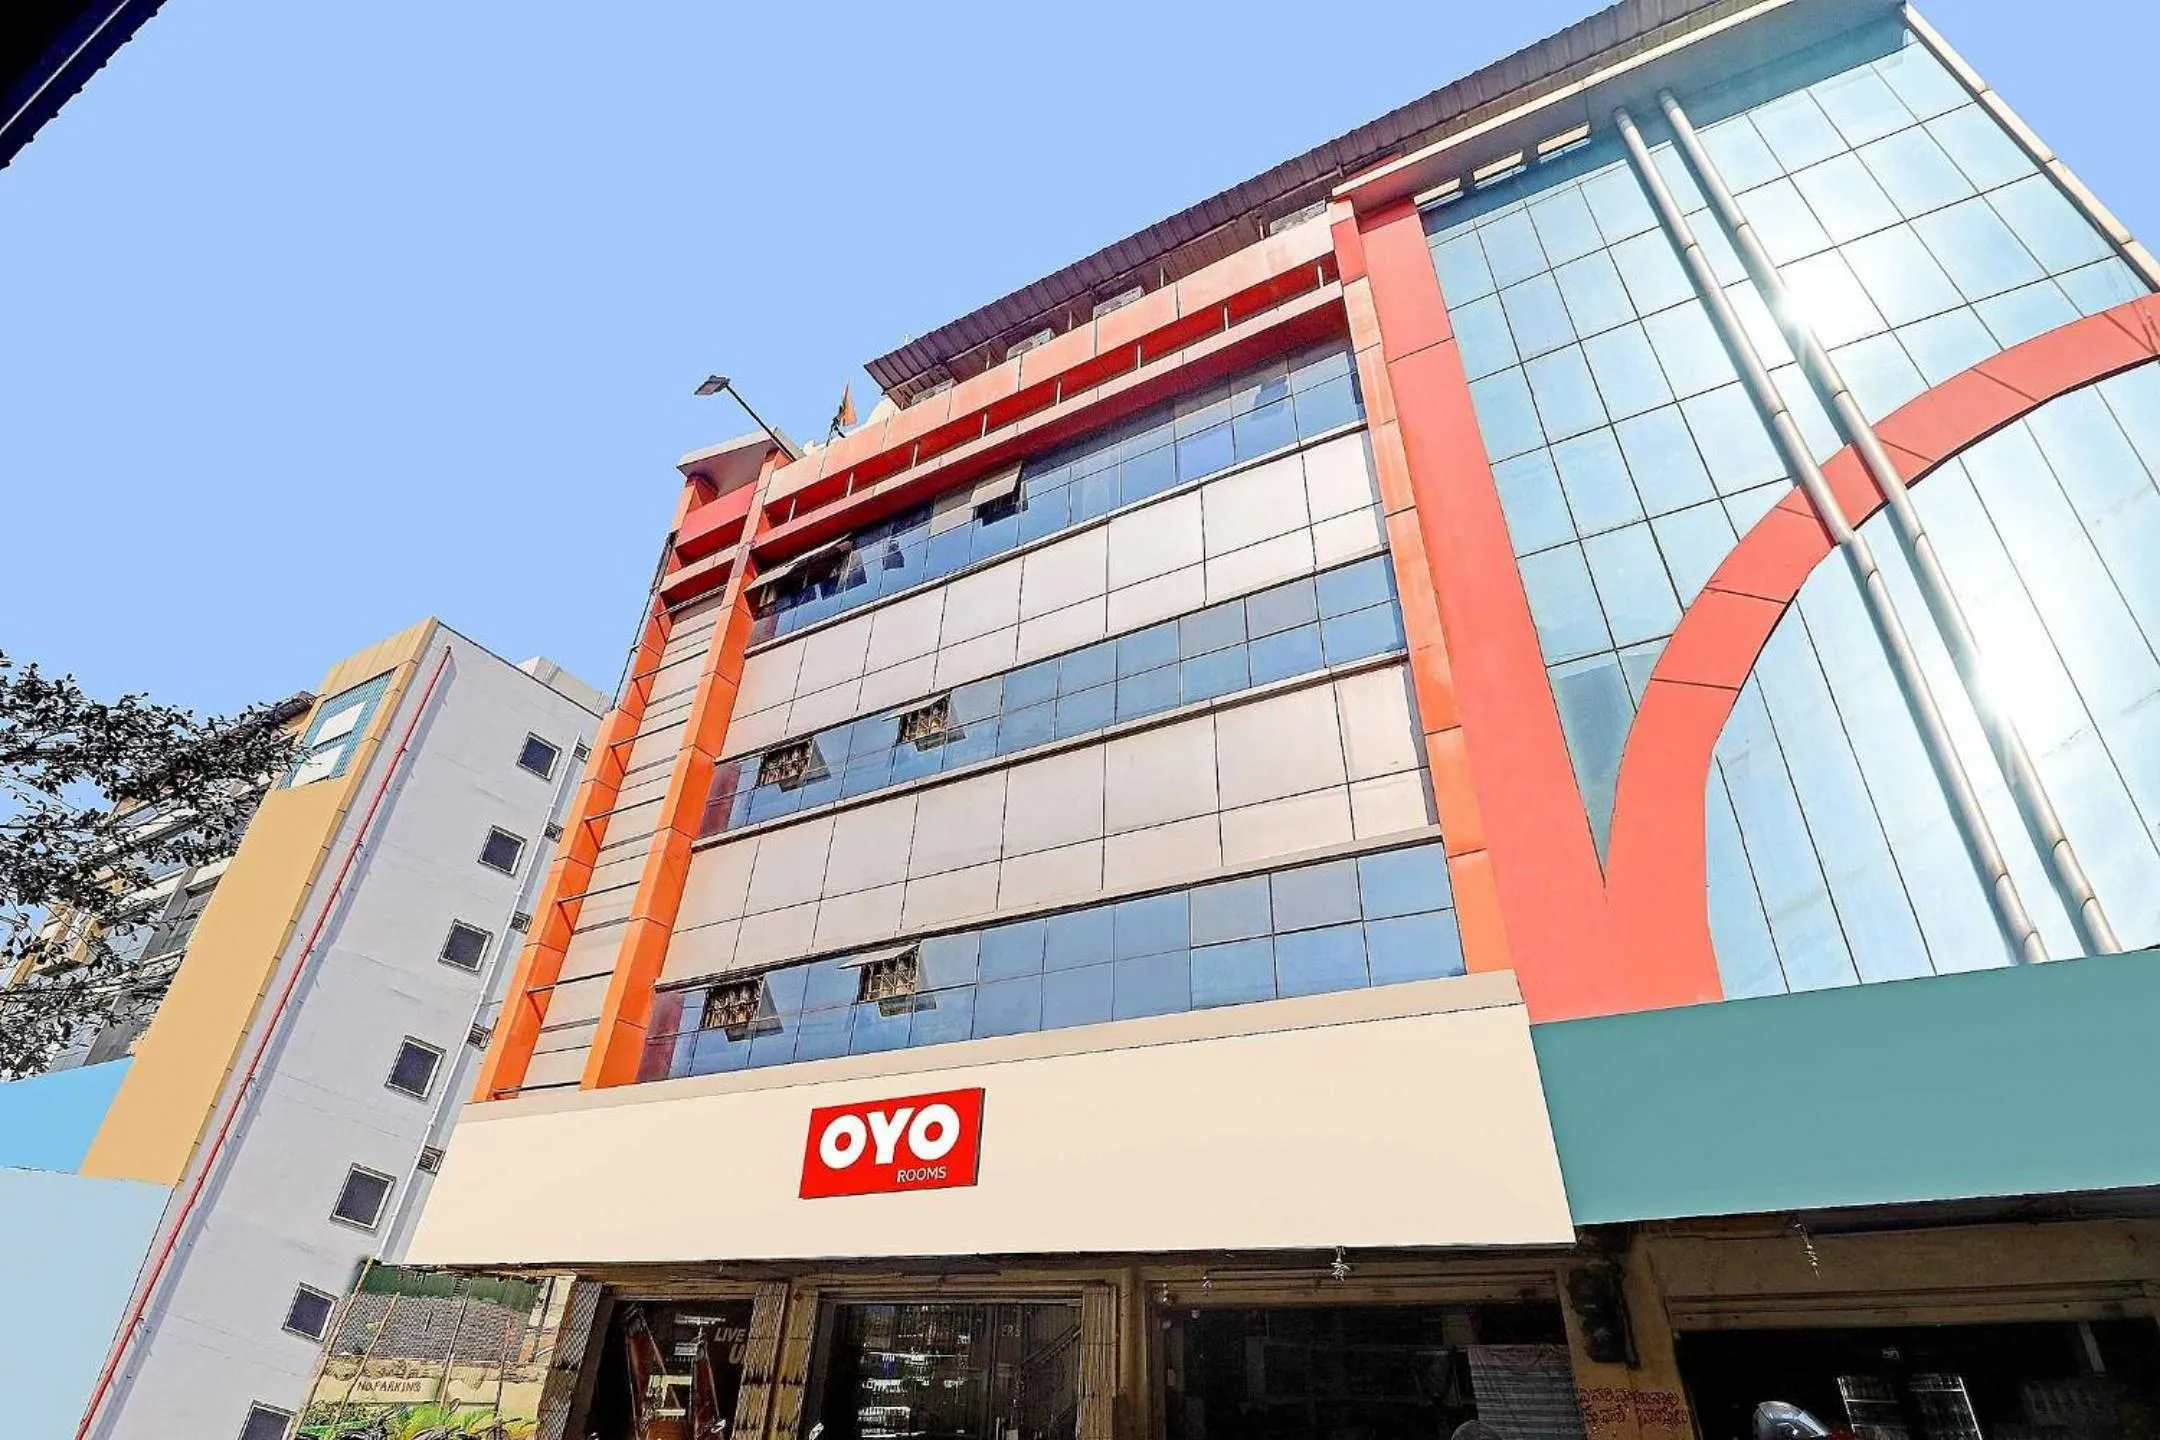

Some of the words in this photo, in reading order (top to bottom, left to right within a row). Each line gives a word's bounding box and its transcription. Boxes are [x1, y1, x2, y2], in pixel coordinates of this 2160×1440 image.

[819, 1103, 960, 1169] OYO
[896, 1166, 947, 1183] ROOMS
[713, 1327, 747, 1343] LIVE
